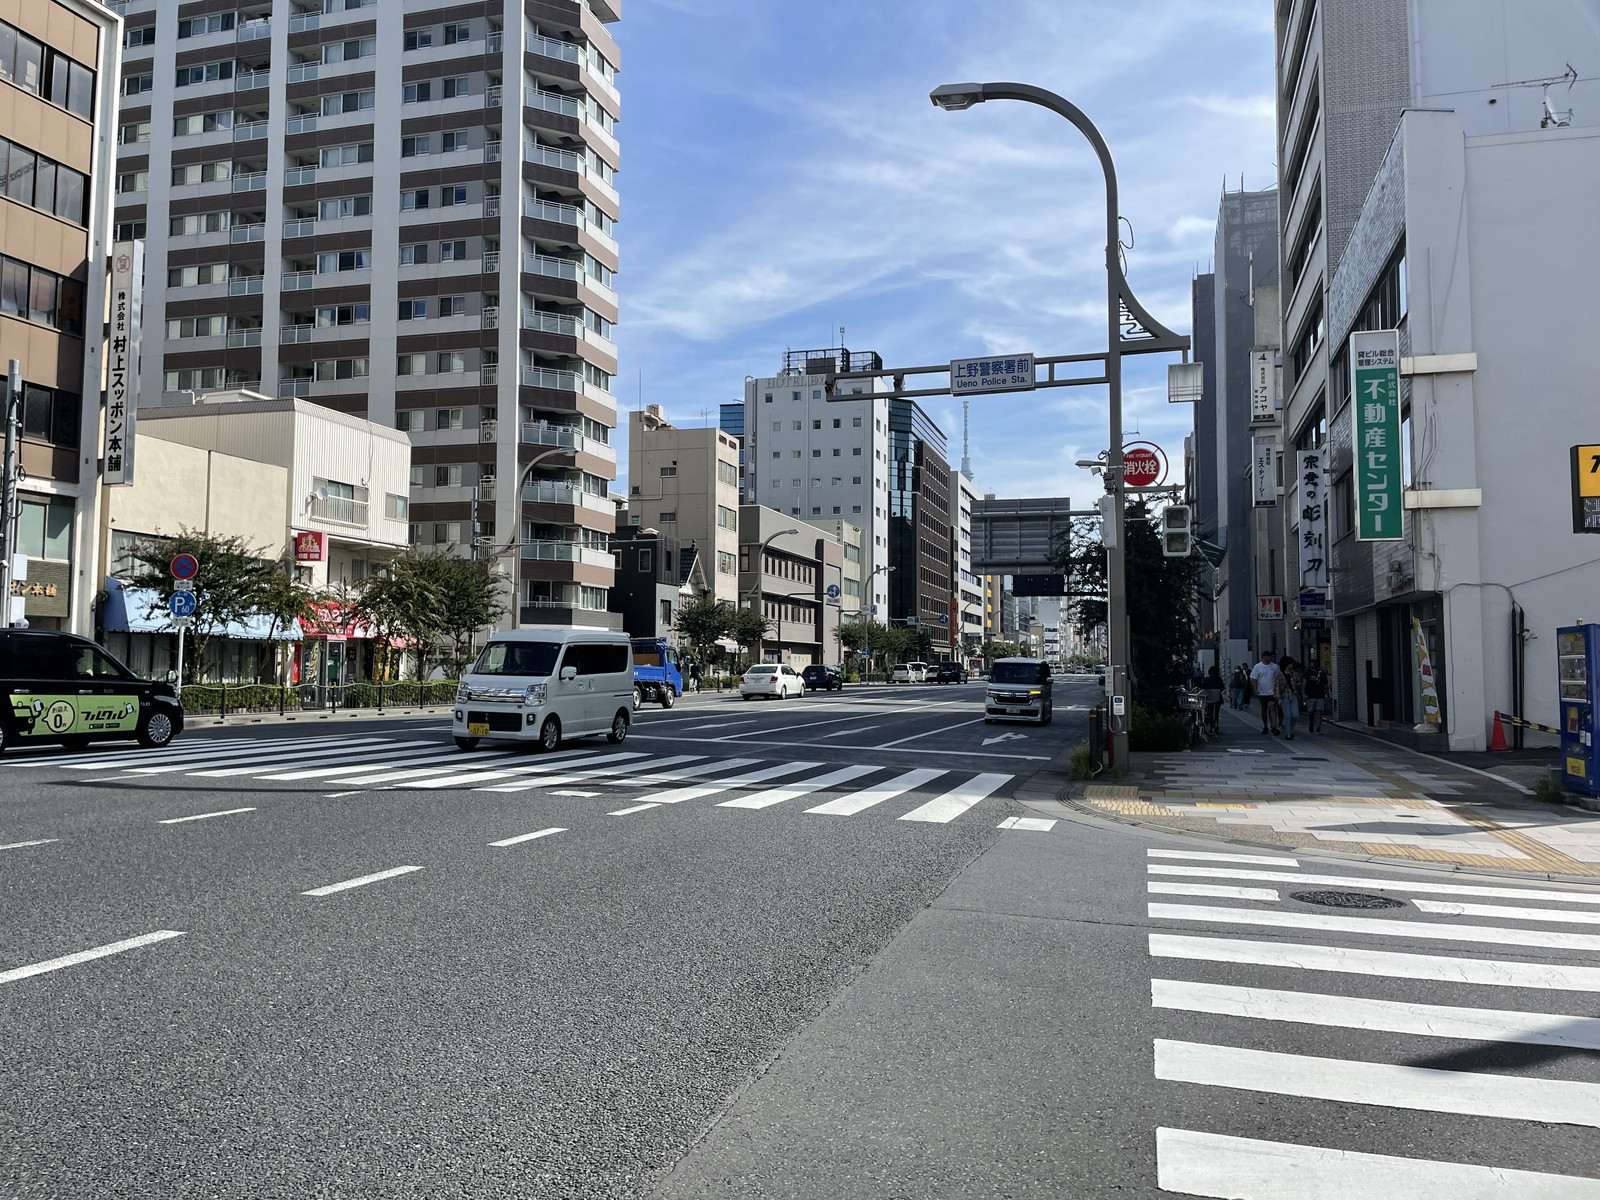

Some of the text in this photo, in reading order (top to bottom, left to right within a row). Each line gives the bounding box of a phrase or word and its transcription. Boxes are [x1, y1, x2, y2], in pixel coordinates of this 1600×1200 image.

[1358, 349, 1394, 358] 貸ビル総合
[1358, 358, 1394, 367] 管理システム
[954, 359, 1029, 378] 上野警察署前
[107, 292, 127, 472] 株式会社 村上スッポン本舗
[957, 375, 1027, 388] Ueno Police Sta.
[1387, 373, 1396, 406] 株式会社
[1259, 386, 1268, 412] アコヤ
[1363, 379, 1389, 532] 不動産センター
[1124, 459, 1157, 475] 消火栓
[174, 596, 190, 613] P 60
